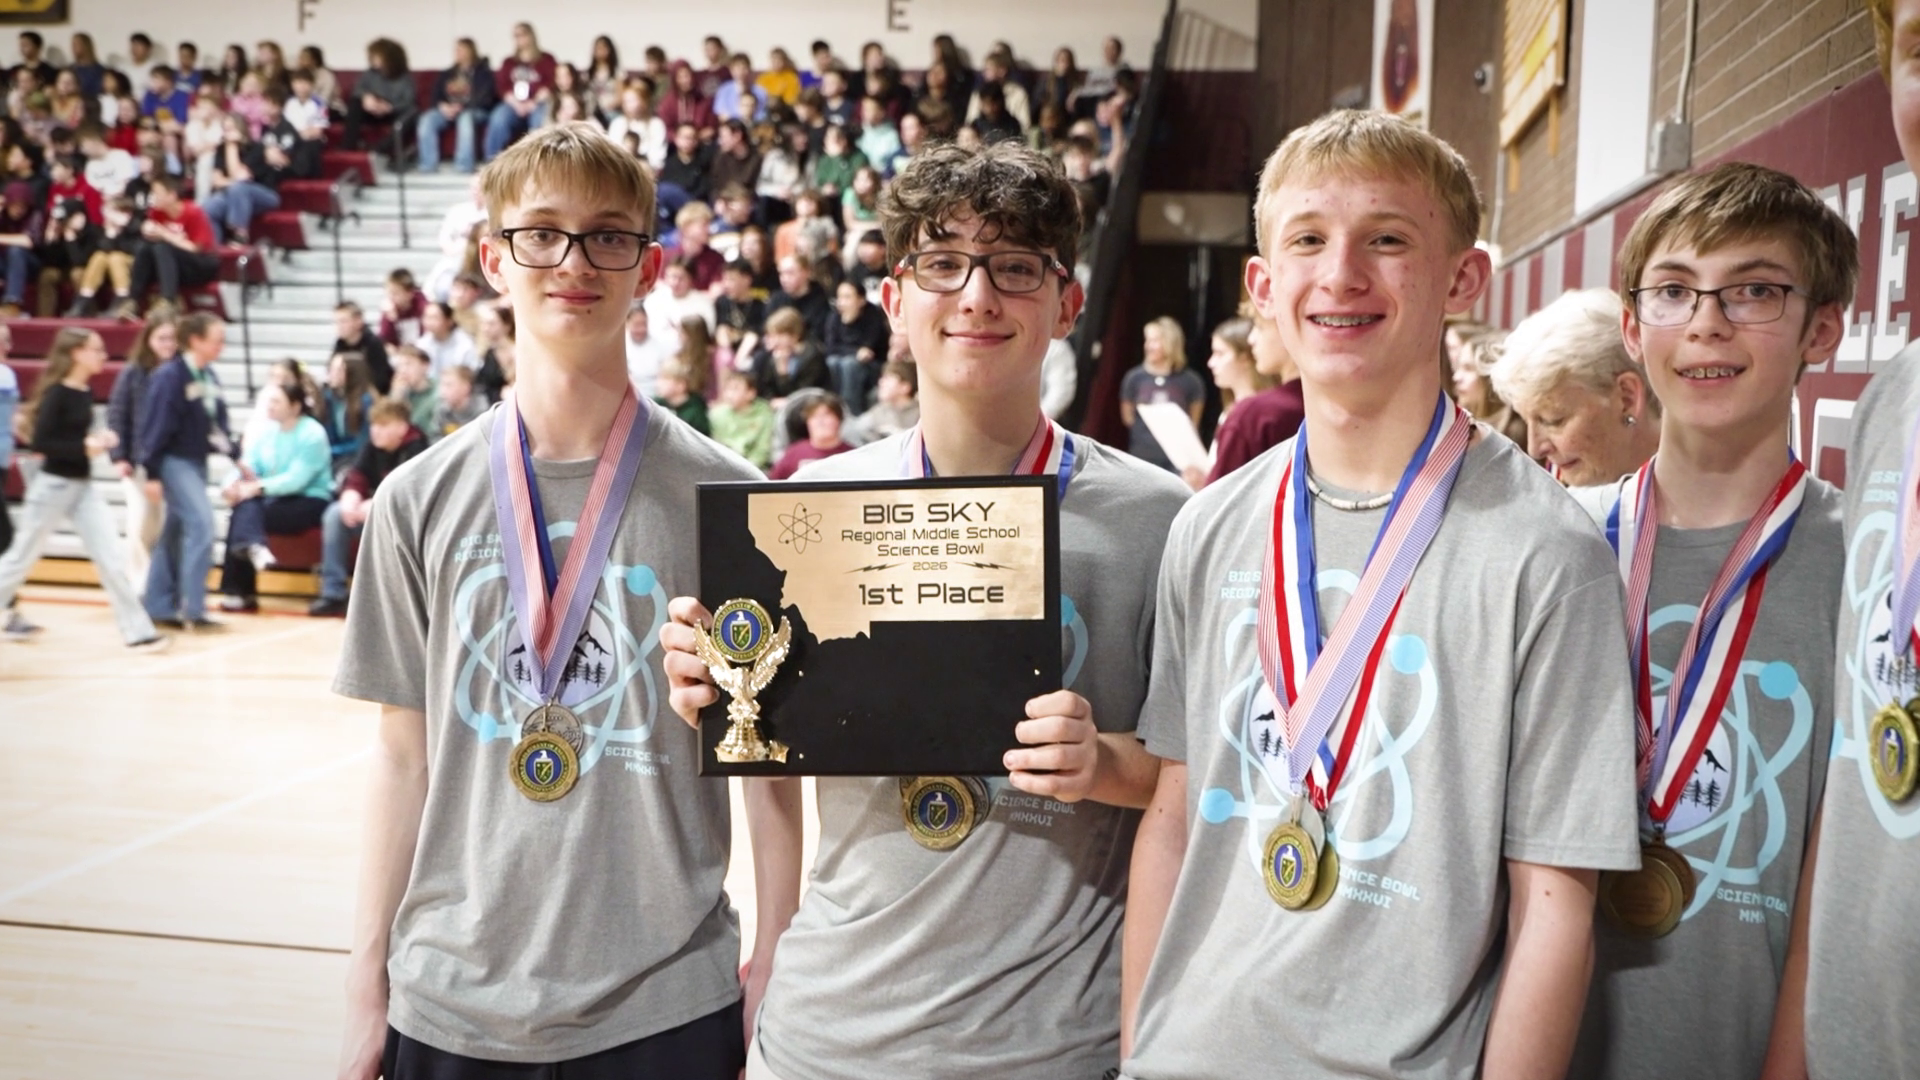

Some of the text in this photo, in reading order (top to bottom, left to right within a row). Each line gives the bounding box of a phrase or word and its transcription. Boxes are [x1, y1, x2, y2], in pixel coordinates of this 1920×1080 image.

[863, 502, 996, 524] BIG SKY
[841, 526, 1020, 544] Regional Middle School
[877, 543, 984, 557] Science Bowl
[912, 561, 948, 571] 2026
[859, 582, 1004, 605] 1st Place
[1043, 800, 1076, 815] BOWL
[1381, 876, 1421, 901] BOWL
[1716, 887, 1762, 905] SCIEN
